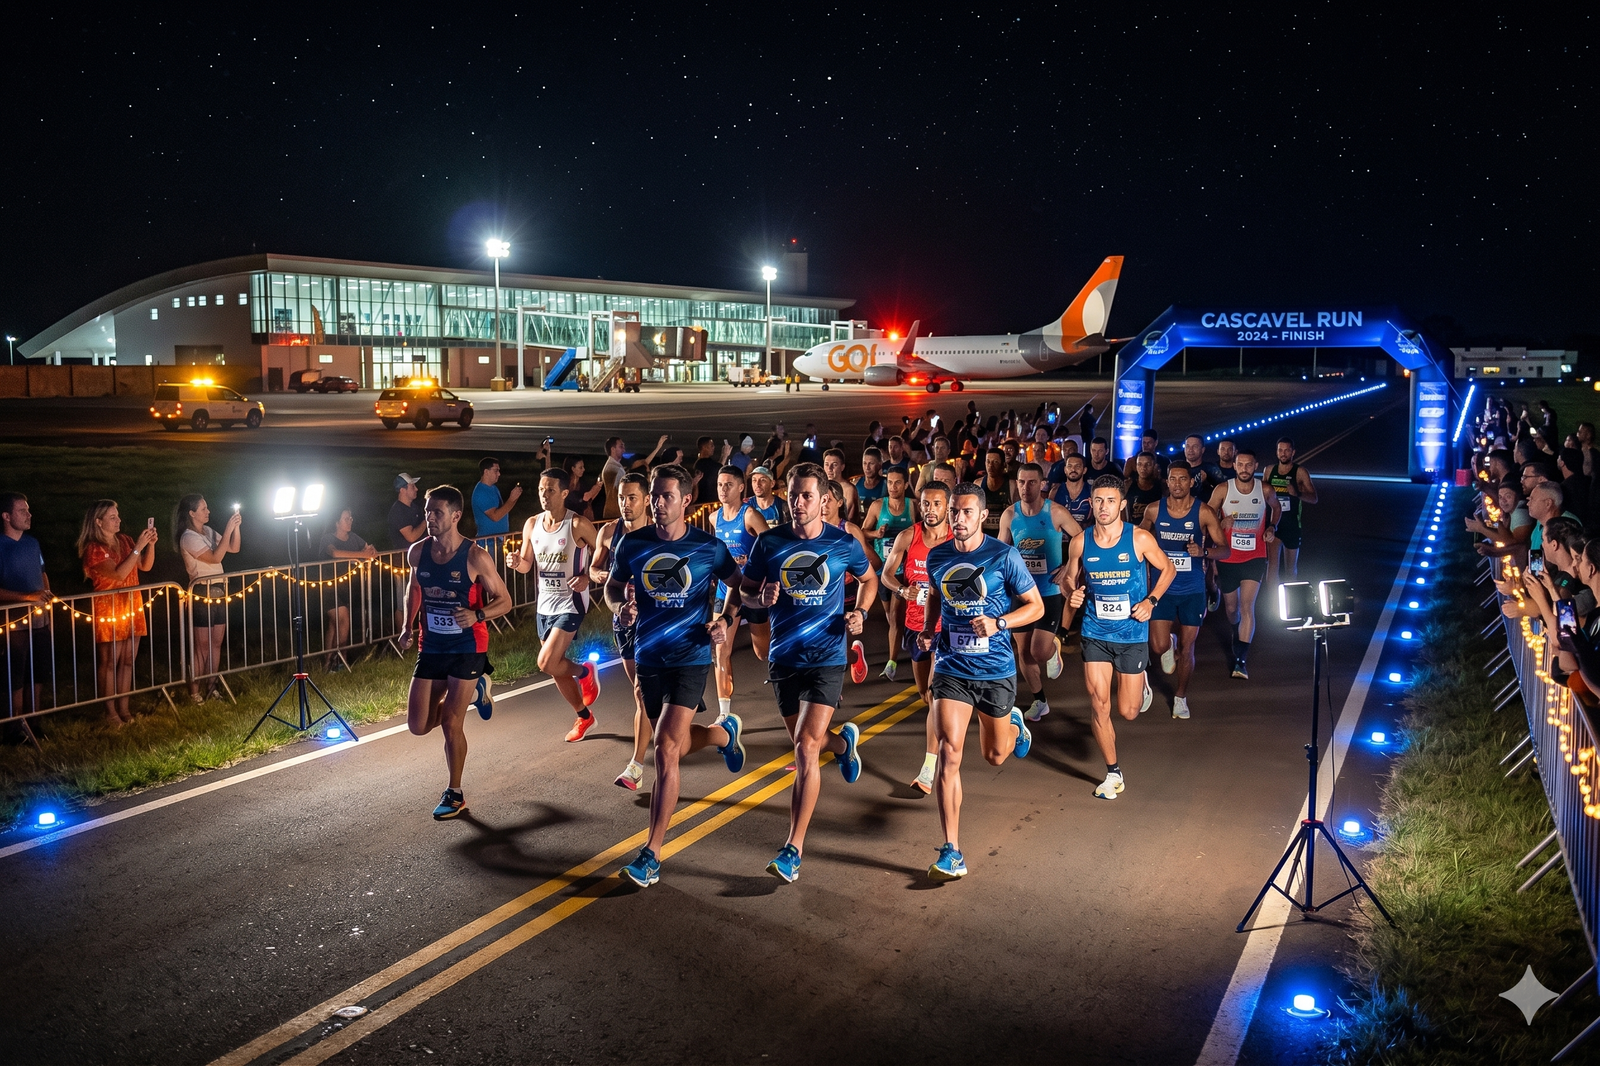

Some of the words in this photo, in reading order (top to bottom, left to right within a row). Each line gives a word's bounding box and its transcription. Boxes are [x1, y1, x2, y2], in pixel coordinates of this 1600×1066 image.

[1201, 312, 1312, 329] CASCAVEL
[1317, 311, 1363, 328] RUN
[1237, 331, 1269, 341] 2024
[1281, 331, 1324, 341] FINISH
[1102, 603, 1123, 613] 824
[433, 616, 454, 627] 533
